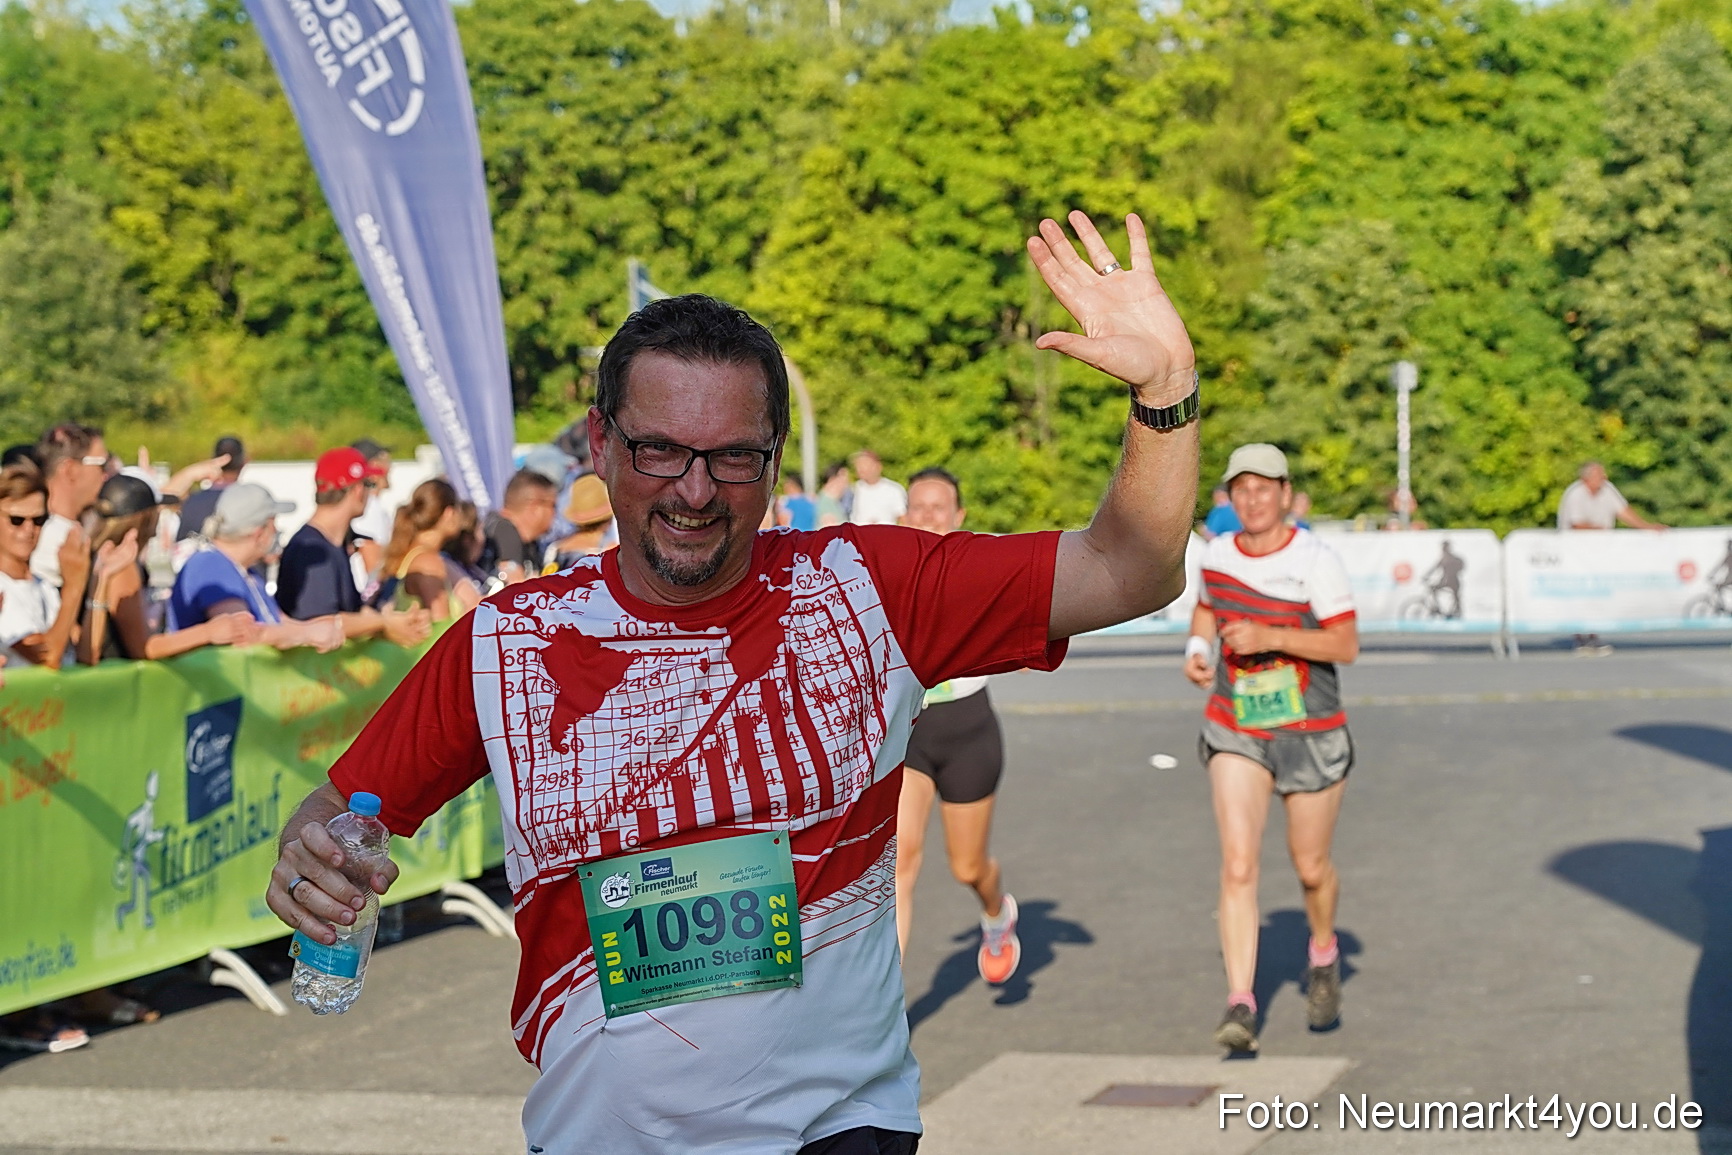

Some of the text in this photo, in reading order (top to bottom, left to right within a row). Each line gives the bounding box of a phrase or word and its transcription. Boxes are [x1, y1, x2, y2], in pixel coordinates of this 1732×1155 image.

[613, 621, 673, 637] 10.54
[620, 726, 680, 750] 26.22
[634, 871, 697, 895] Firmenlauf
[660, 881, 698, 896] neumarkt
[623, 890, 764, 958] 1098
[768, 893, 792, 965] 2022
[314, 951, 337, 964] Quelle
[601, 931, 625, 985] RUN
[624, 946, 774, 984] Witmann Stefan
[641, 984, 672, 995] Sparkasse
[673, 976, 704, 988] Neumarkt
